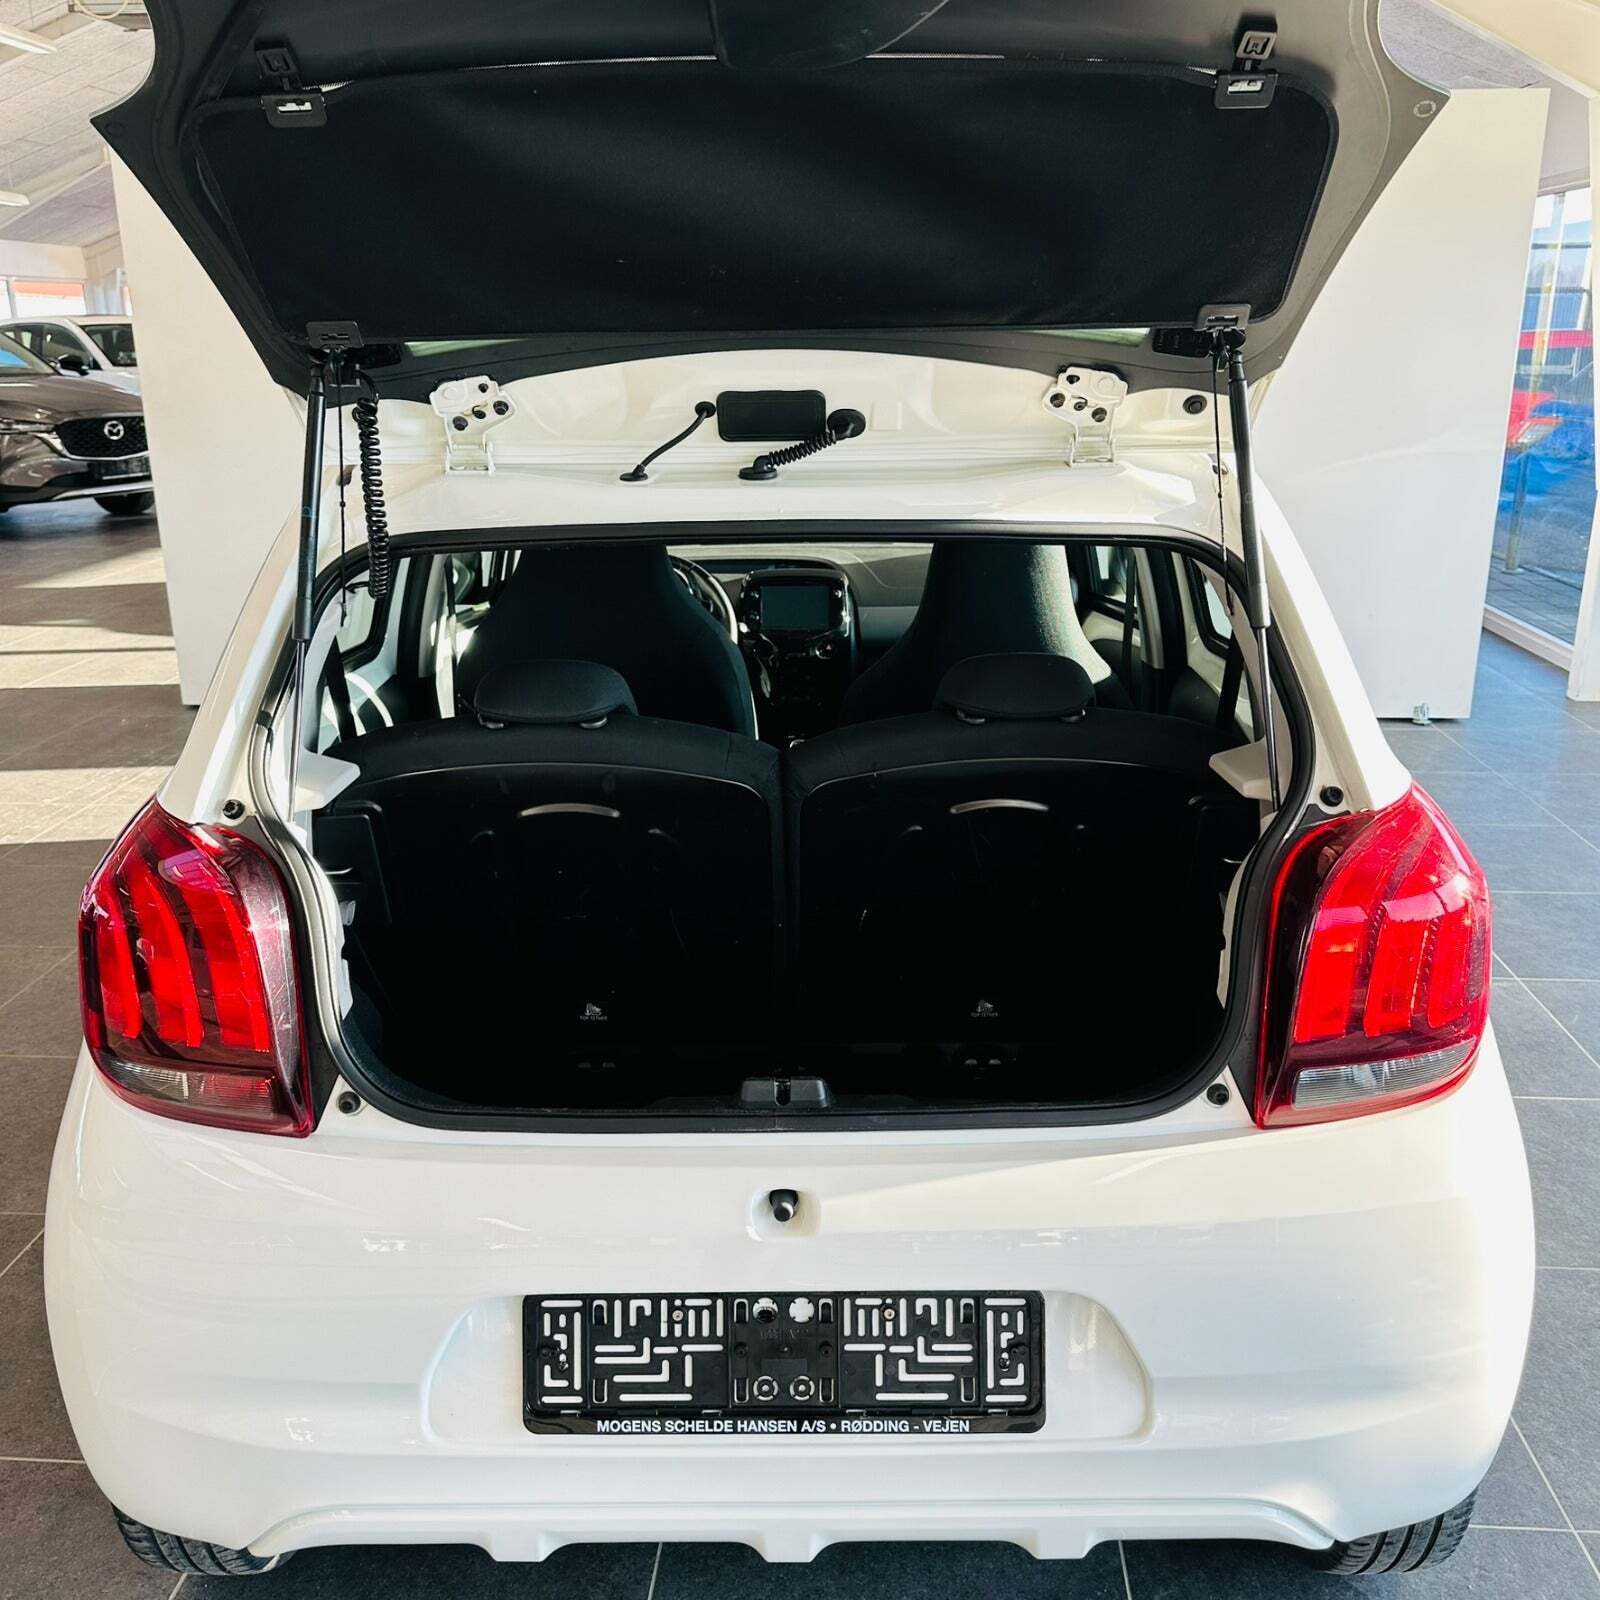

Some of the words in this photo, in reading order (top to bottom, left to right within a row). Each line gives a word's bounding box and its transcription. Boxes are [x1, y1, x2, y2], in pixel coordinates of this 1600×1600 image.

[597, 1420, 661, 1432] MOGENS
[664, 1420, 734, 1432] SCHELDE
[737, 1420, 797, 1432] HANSEN
[801, 1420, 826, 1432] A/S
[841, 1420, 909, 1432] RØDDING
[923, 1420, 970, 1432] VEJEN
